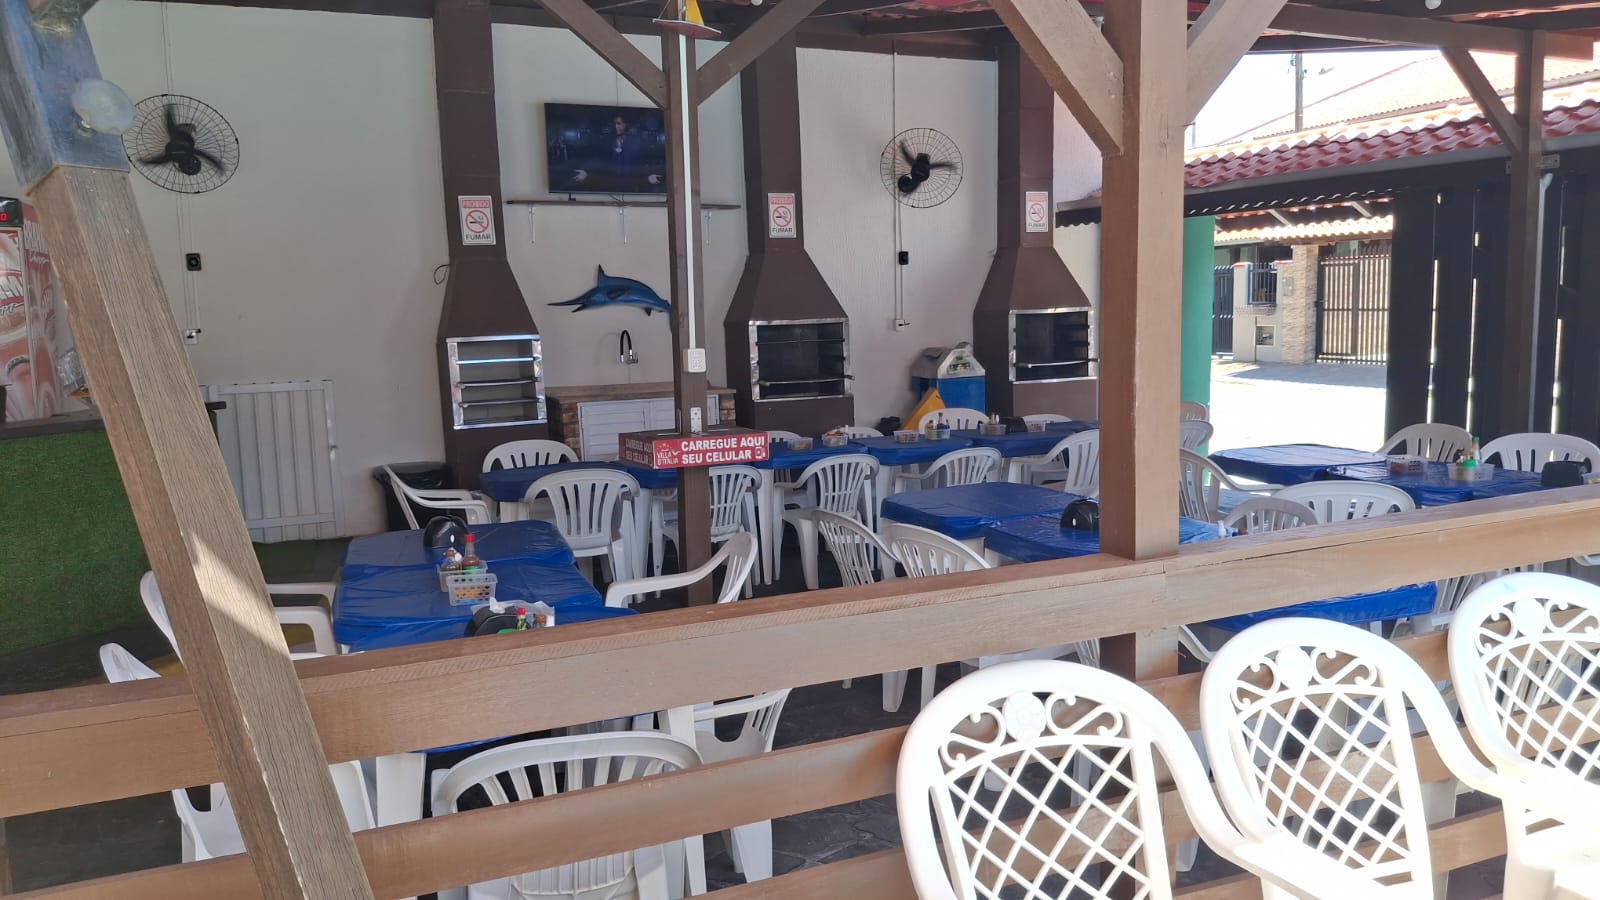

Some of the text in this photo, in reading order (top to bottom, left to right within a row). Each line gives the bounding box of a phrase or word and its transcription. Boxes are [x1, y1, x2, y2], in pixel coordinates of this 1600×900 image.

[681, 436, 765, 452] CARREGUE AQUI
[681, 450, 751, 465] SEU CELULAR
